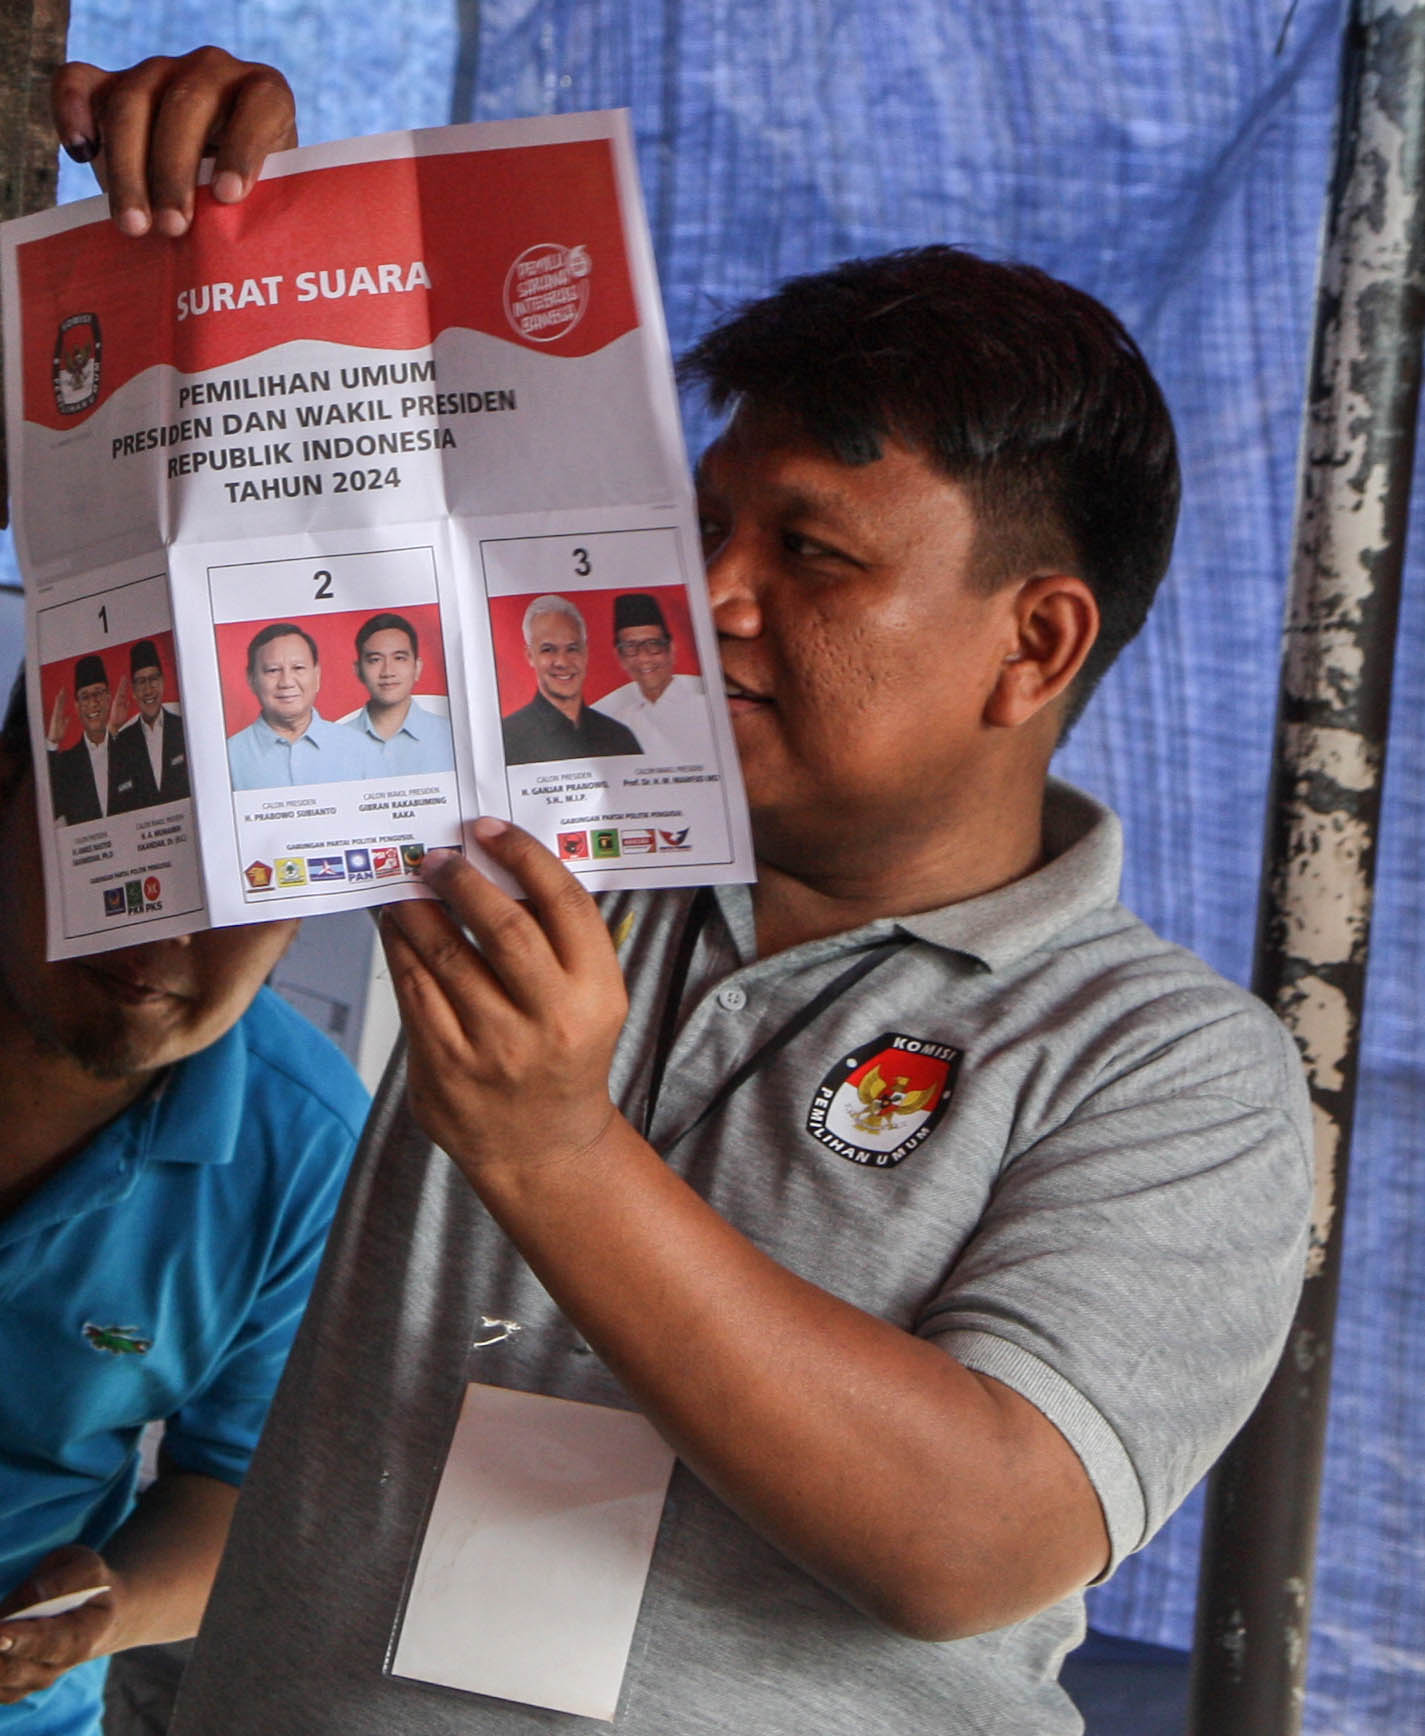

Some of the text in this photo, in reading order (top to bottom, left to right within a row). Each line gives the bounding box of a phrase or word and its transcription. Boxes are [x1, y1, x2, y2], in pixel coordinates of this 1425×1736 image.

[176, 261, 432, 322] SURAT SUARA
[178, 360, 437, 408] PEMILIHAN UMUM
[112, 416, 213, 459] PRESIDEN
[222, 409, 287, 435] DAN
[296, 399, 392, 428] WAKIL
[400, 389, 516, 418] PRESIDEN
[168, 428, 457, 479] REPUBLIK INDONESIA
[224, 467, 402, 503] TAHUN 2024
[573, 547, 593, 577] 3
[312, 569, 334, 600] 2
[97, 604, 110, 634] 1
[362, 792, 386, 800] CALON
[408, 787, 441, 796] PRESIDEN
[531, 785, 564, 795] GANJAR
[254, 811, 295, 822] PRABOWO
[296, 807, 337, 818] SUBIANTO
[262, 799, 317, 810] CALON PRESIDEN
[358, 796, 448, 812] GIBRAN RAKABUMING
[392, 811, 416, 819] RAKA
[286, 841, 325, 850] GABUNGAN
[326, 839, 350, 847] PARTAI
[351, 837, 377, 845] POLITIK
[348, 871, 374, 882] PAN
[146, 901, 163, 912] PKS
[893, 1036, 957, 1061] KOMISI
[809, 1086, 931, 1165] PEMILIHAN UMUM
